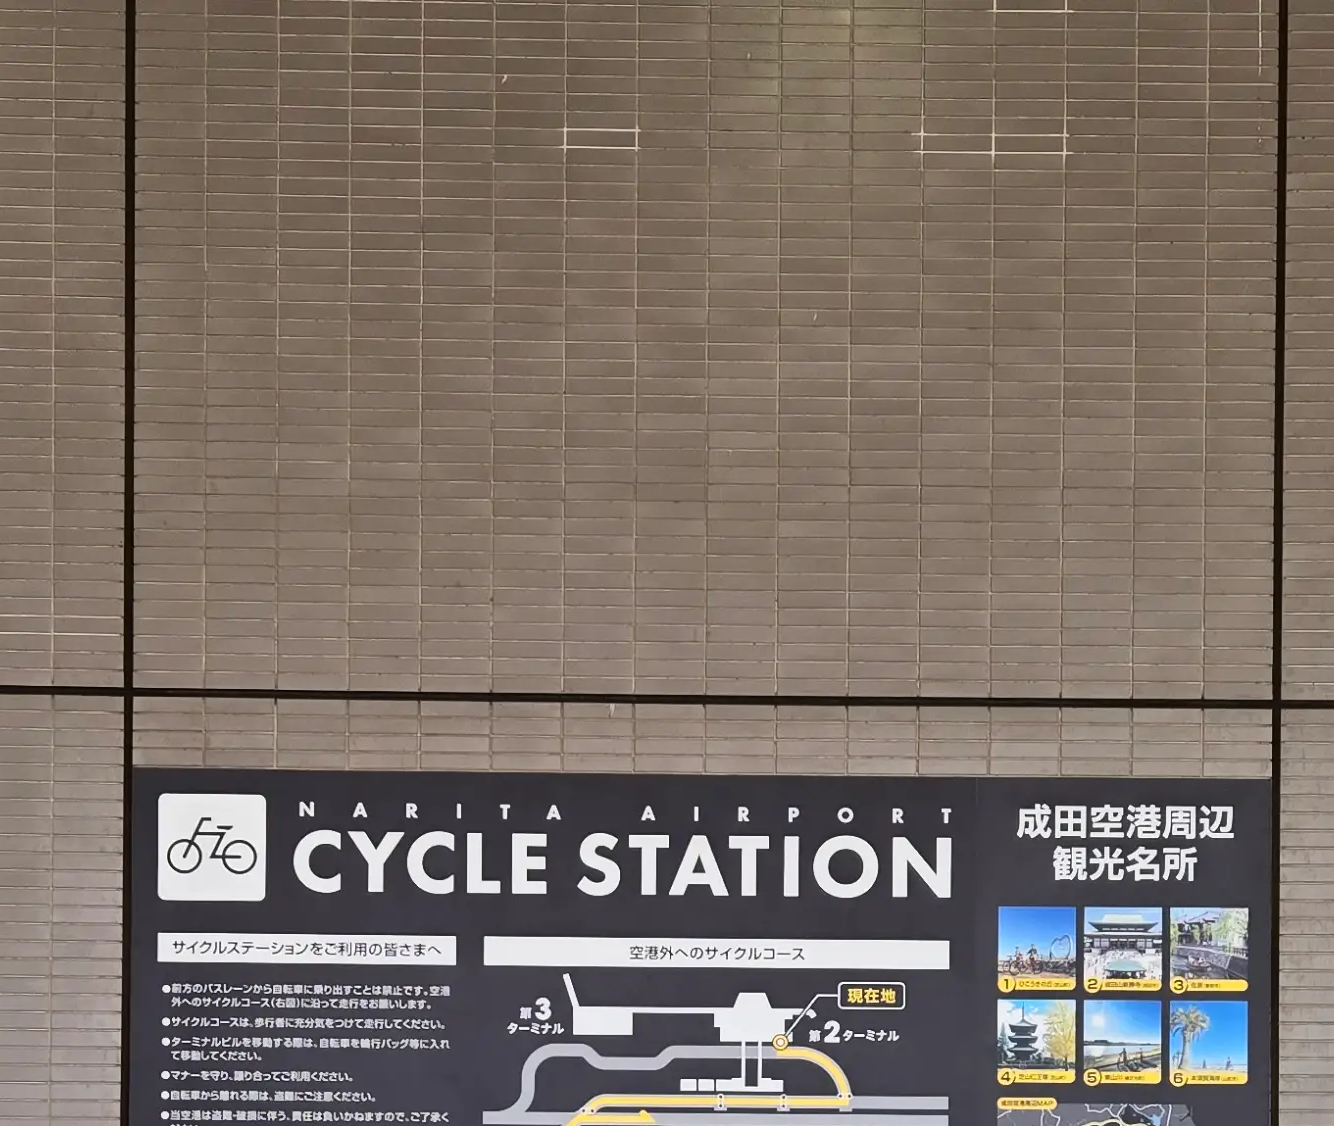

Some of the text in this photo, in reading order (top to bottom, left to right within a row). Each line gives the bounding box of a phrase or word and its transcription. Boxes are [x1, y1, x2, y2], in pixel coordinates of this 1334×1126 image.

[299, 802, 951, 823] NARITA AIRPORT
[1017, 804, 1234, 839] 成田空港周辺
[293, 830, 951, 898] CYCLE STATION
[1053, 846, 1197, 881] 観光名所
[173, 941, 441, 957] サイクルステーションをご利用の皆さまへ
[630, 946, 804, 960] 空港外へのサイクルコース
[1004, 979, 1009, 990] 1
[1088, 979, 1098, 990] 2
[1174, 980, 1183, 990] 3
[848, 988, 896, 1003] 現在地
[507, 1023, 564, 1034] ターミナル
[1001, 1071, 1011, 1082] 4
[1087, 1072, 1097, 1083] 5
[1174, 1073, 1183, 1084] 6
